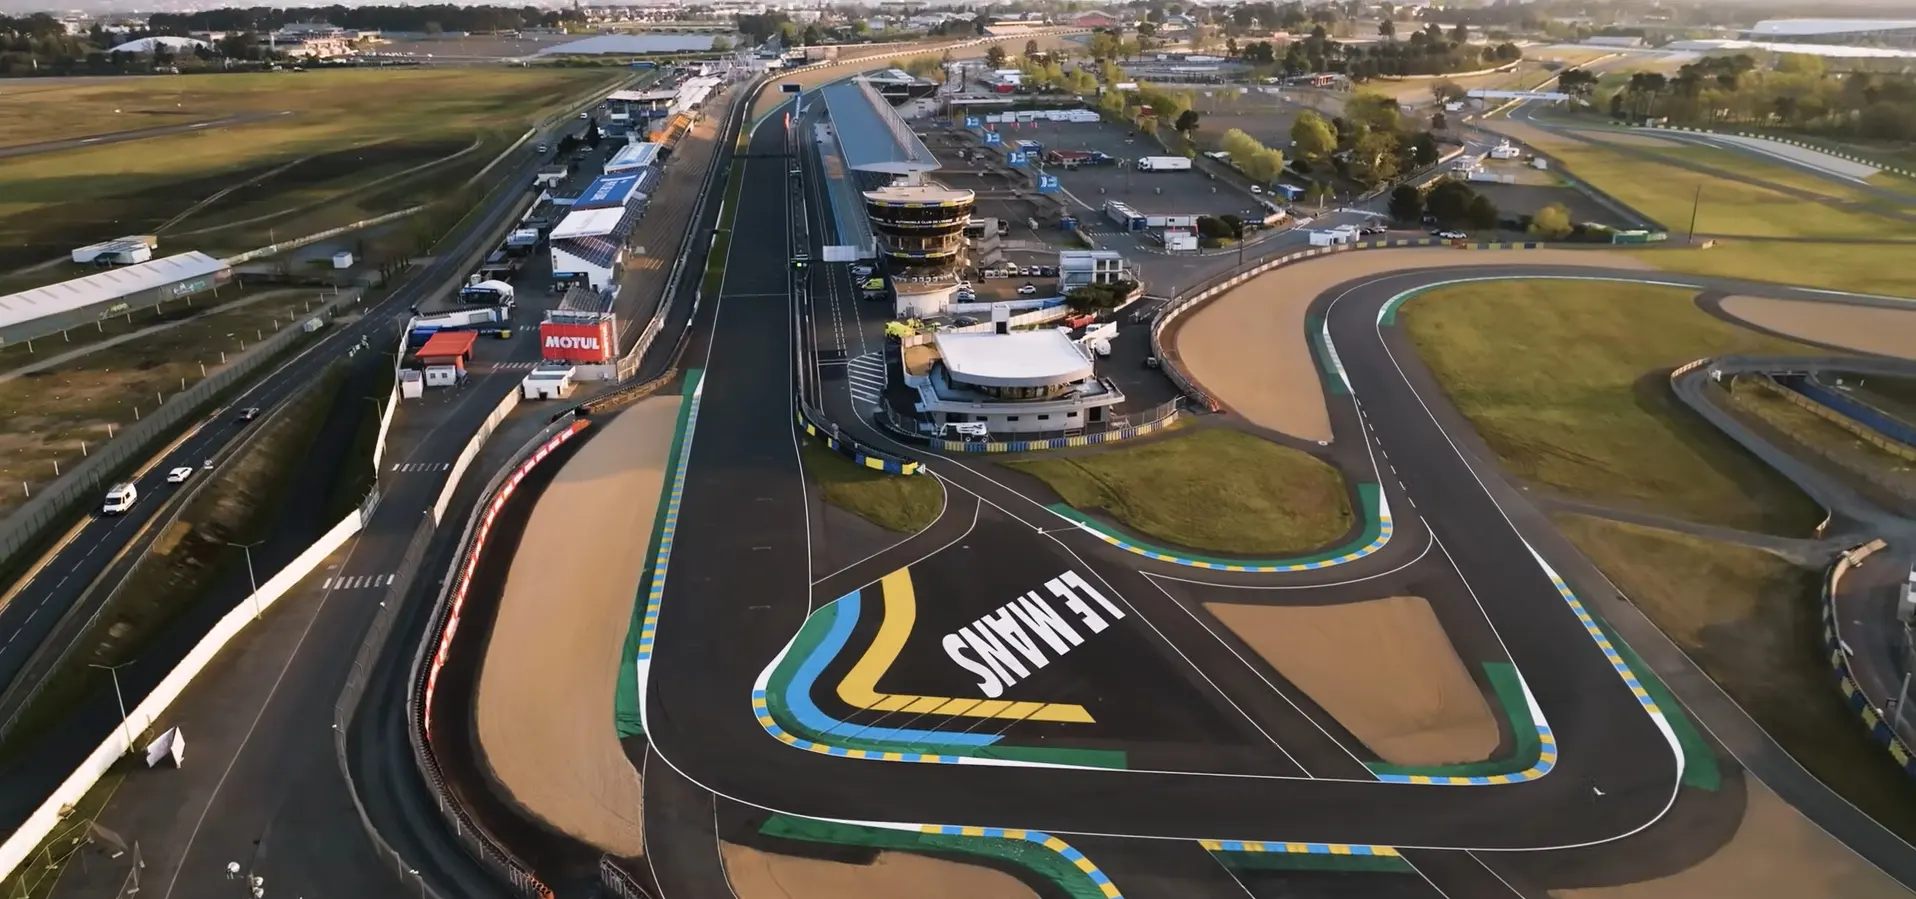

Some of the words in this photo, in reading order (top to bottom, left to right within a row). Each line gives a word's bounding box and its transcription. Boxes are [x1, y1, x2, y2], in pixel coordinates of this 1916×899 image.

[545, 336, 600, 350] MOTUL
[1044, 570, 1126, 634] LE
[942, 590, 1085, 698] MANS
